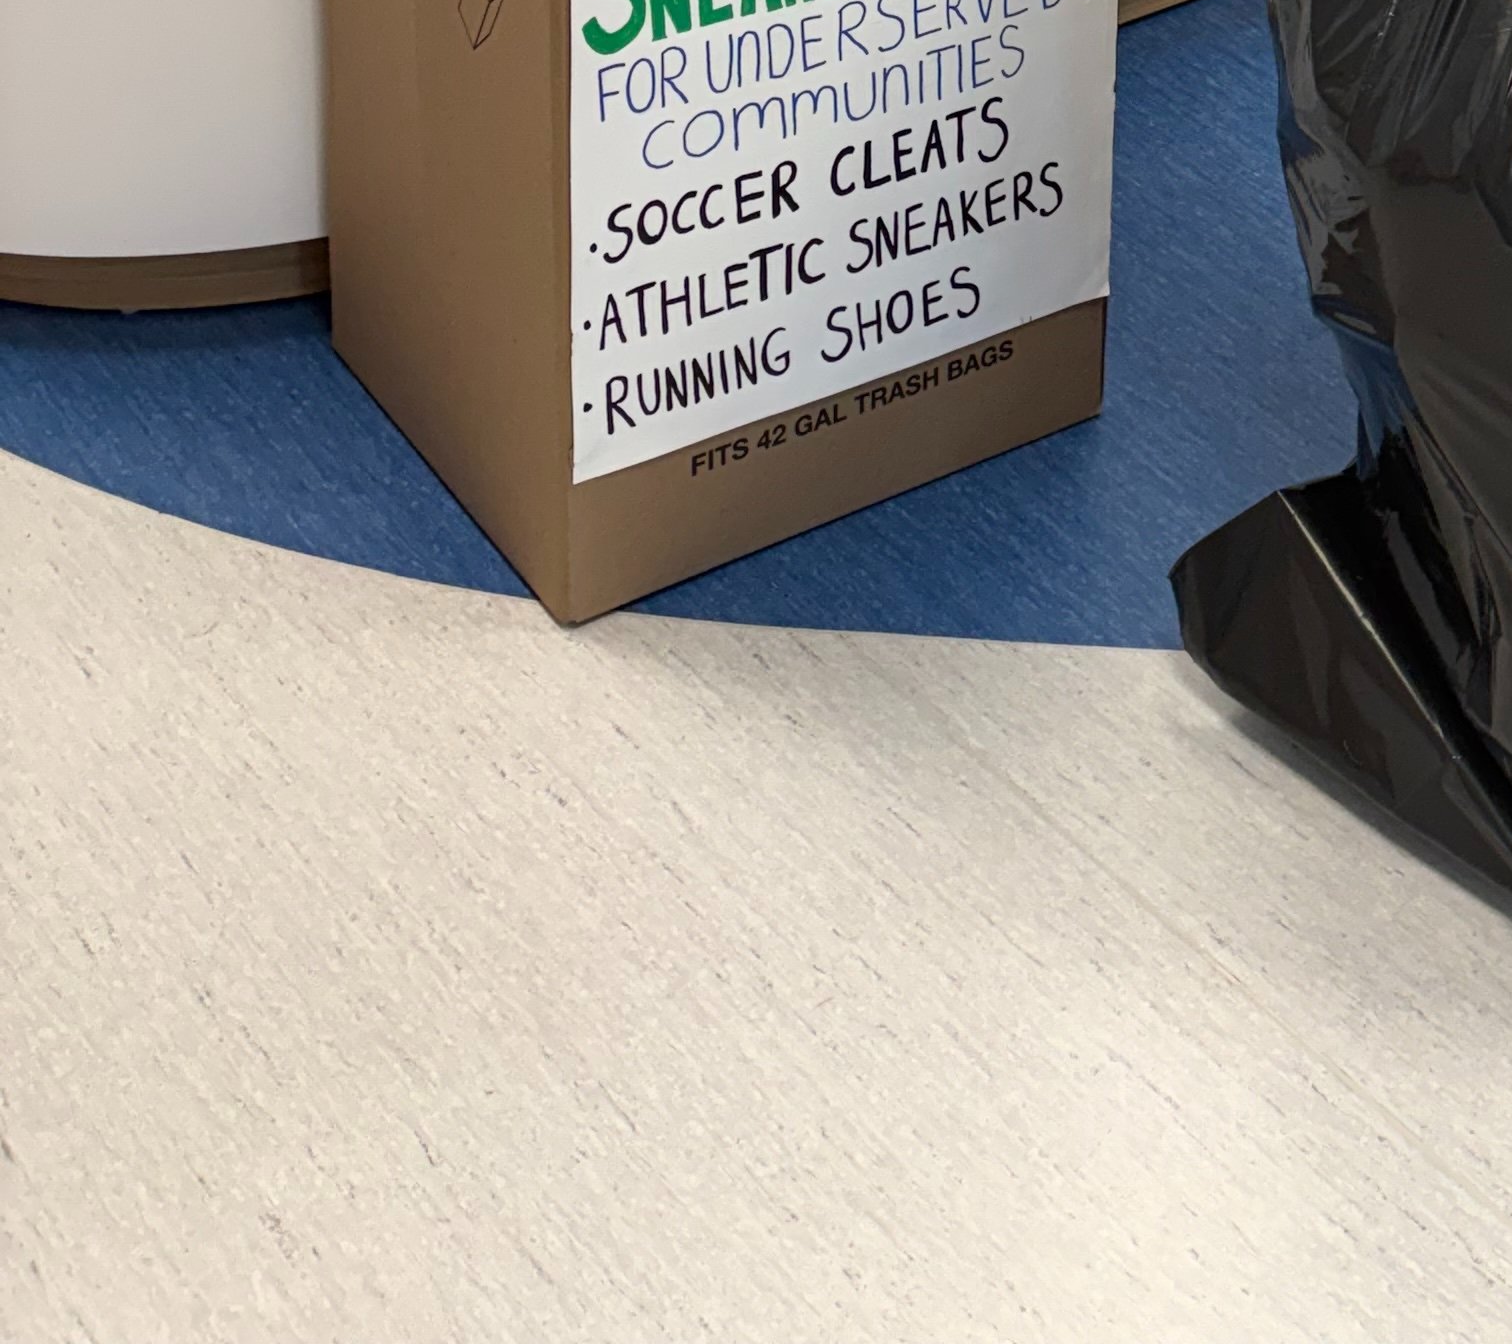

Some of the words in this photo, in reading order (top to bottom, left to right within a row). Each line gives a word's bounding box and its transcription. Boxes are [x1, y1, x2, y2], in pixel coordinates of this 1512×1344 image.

[597, 45, 689, 123] FOR
[598, 237, 827, 351] ATHLETIC
[846, 162, 1064, 275] SNEAKERS
[602, 160, 799, 264] SOCCER
[830, 97, 1010, 198] CLEATS
[605, 326, 793, 436] RUNNING
[821, 266, 982, 364] SHOES
[690, 439, 749, 477] FITS
[756, 423, 788, 452] 42
[794, 401, 849, 438] GAL
[853, 367, 941, 418] TRASH
[947, 339, 1015, 384] BAGS
